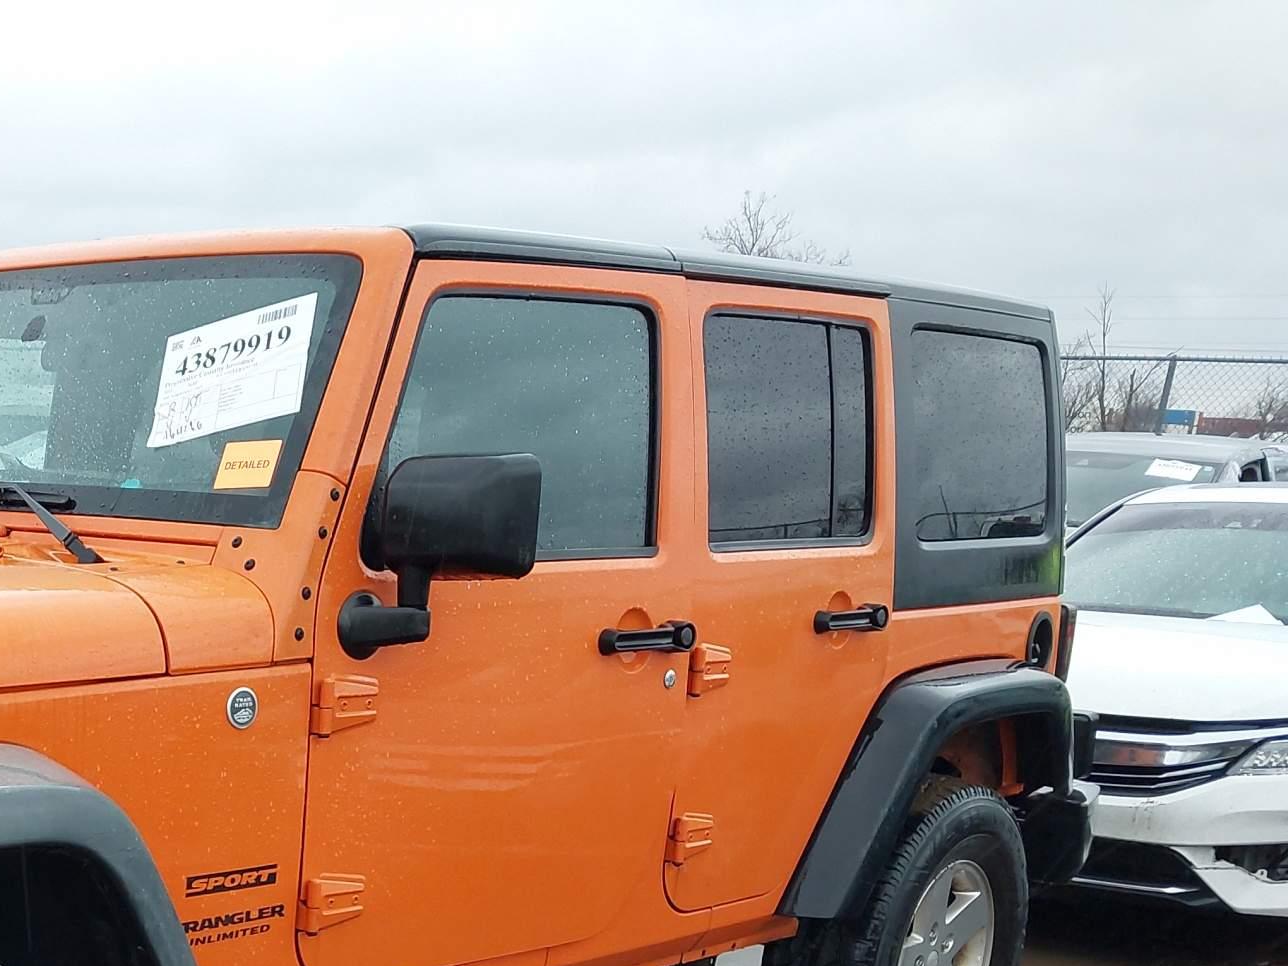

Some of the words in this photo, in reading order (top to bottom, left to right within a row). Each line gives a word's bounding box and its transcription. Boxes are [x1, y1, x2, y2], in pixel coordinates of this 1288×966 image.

[175, 325, 291, 376] 43879919
[224, 459, 270, 470] DETAILED
[186, 869, 277, 894] SPORT
[182, 904, 284, 933] RANGLER
